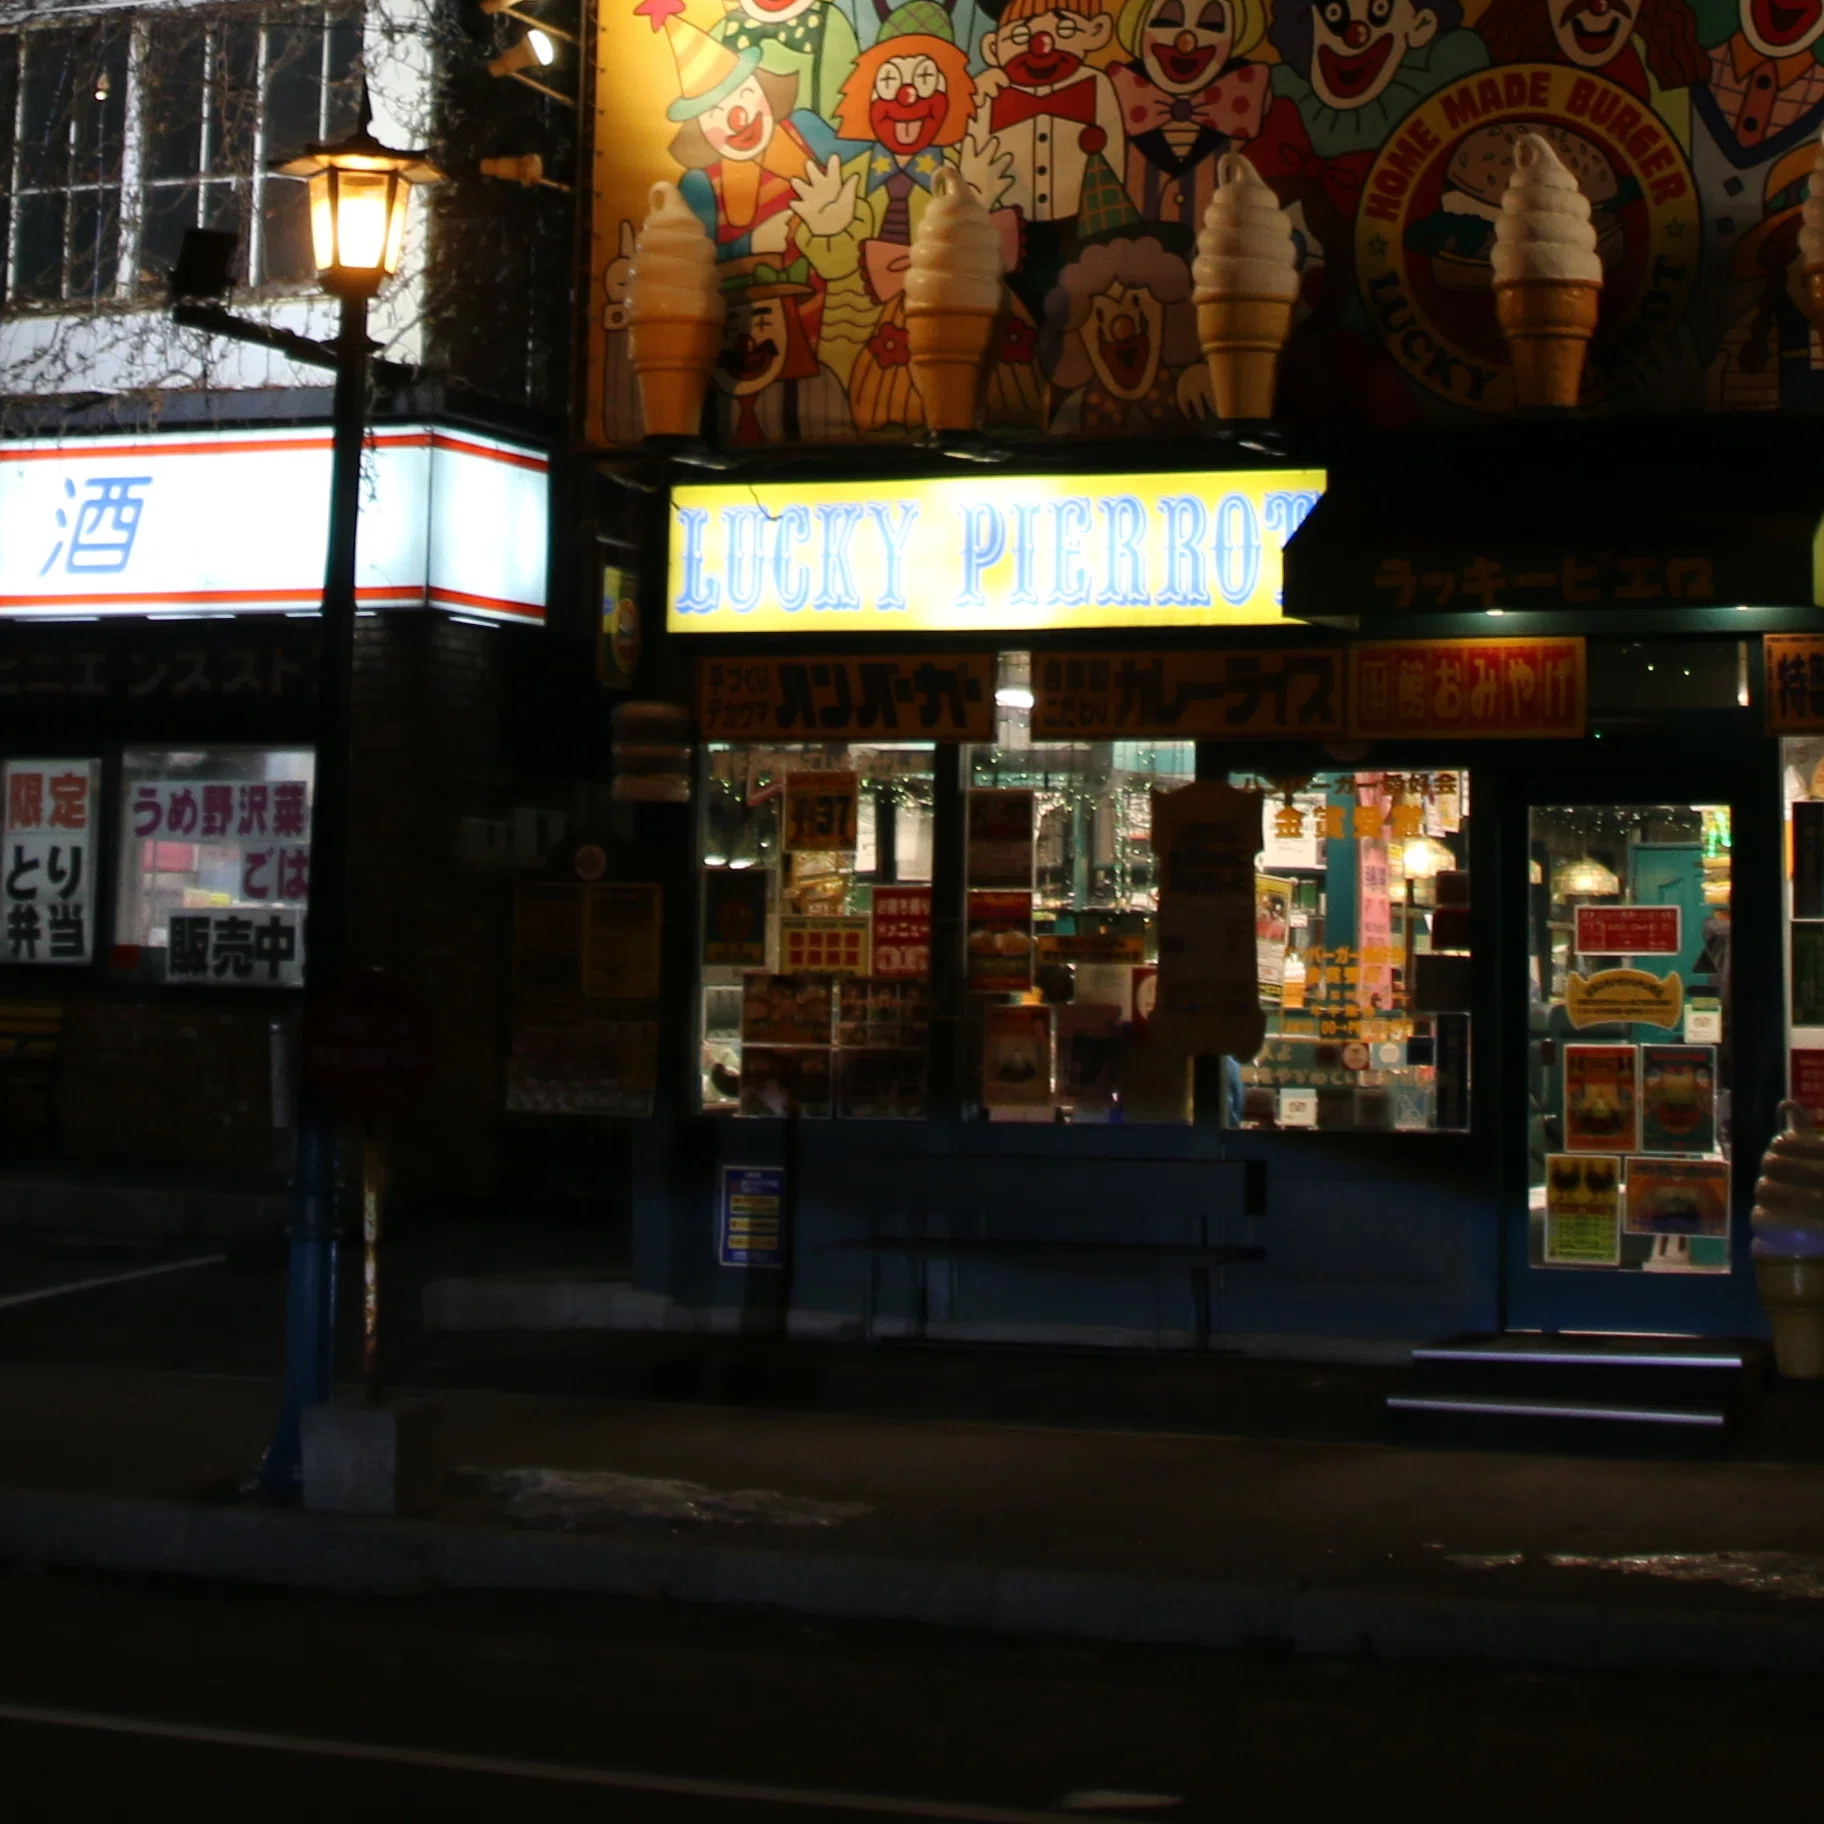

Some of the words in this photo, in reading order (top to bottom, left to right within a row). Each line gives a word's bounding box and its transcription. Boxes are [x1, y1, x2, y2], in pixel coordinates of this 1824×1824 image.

[1365, 119, 1441, 222] HOME
[1437, 71, 1551, 129] MADE
[1565, 77, 1689, 206] BURGER
[1367, 271, 1501, 401] LUCKY
[39, 474, 153, 577] 酒
[674, 499, 920, 613] LUCKY
[1373, 551, 1717, 609] ラッキーピエロ
[776, 662, 983, 729] ハンバーガー
[1114, 657, 1337, 726] カレーライス
[1360, 655, 1573, 722] 函館おみやげ
[133, 784, 305, 838] うめ野沢菜
[7, 903, 86, 960] 弁当
[168, 914, 296, 980] 販売中
